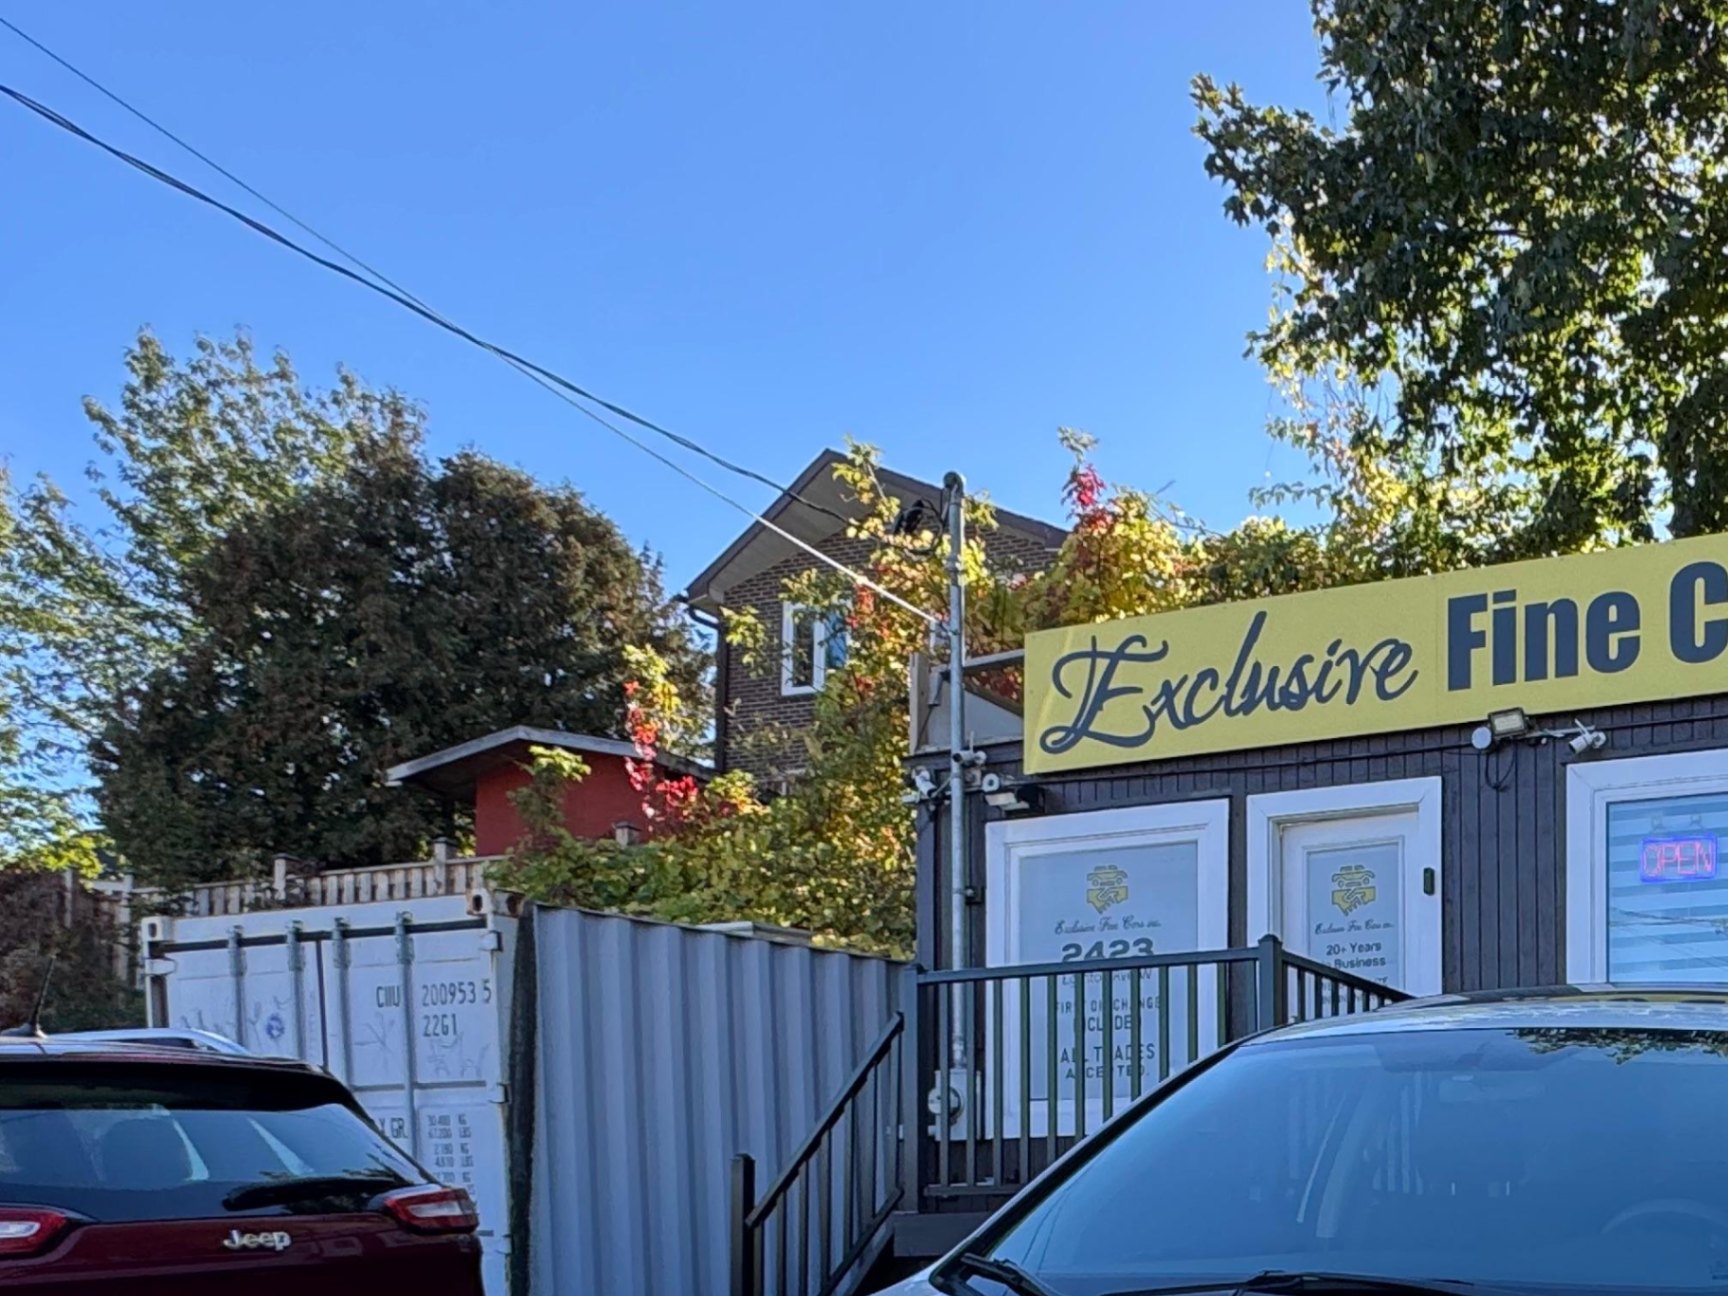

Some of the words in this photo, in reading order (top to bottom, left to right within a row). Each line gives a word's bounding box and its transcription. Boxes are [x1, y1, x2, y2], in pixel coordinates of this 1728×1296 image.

[1040, 612, 1420, 754] Exclusive
[1447, 590, 1641, 692] Fine
[1643, 841, 1714, 877] OPEN
[1350, 942, 1382, 954] Years
[422, 981, 476, 1007] 200953
[223, 1228, 292, 1251] Jeep
